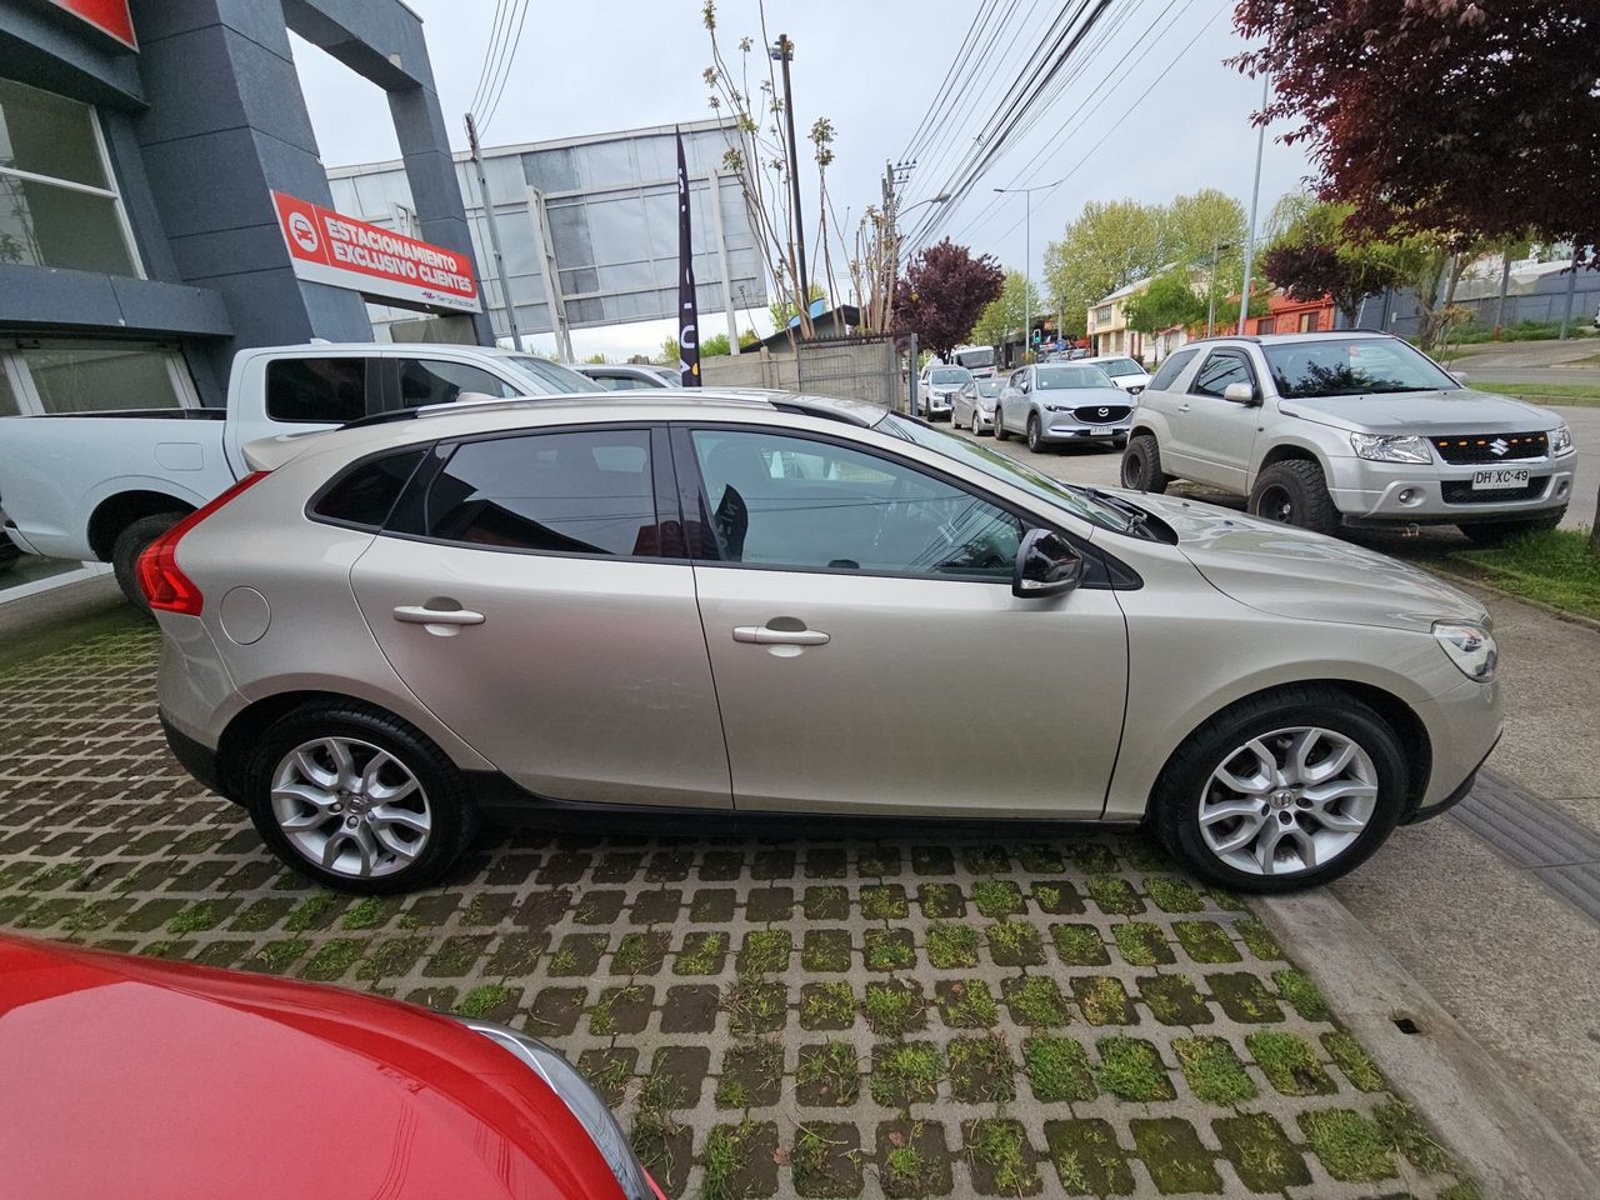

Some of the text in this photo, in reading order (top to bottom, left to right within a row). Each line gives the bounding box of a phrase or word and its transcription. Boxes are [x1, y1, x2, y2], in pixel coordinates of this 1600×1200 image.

[324, 216, 457, 271] ESTACIONAMIENTO
[332, 242, 472, 292] EXCLUSIVO CLIENTES
